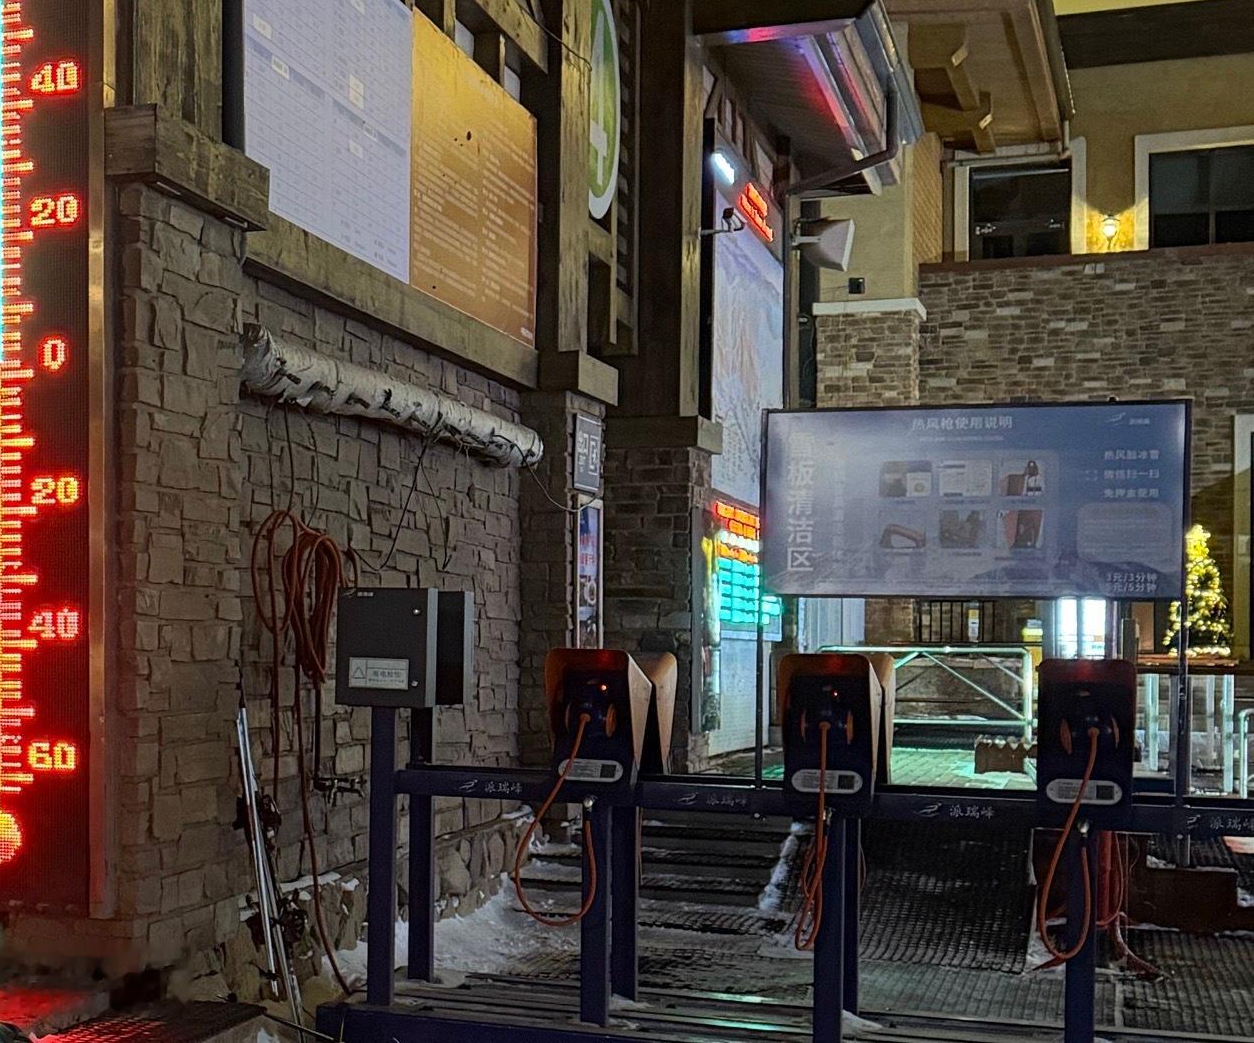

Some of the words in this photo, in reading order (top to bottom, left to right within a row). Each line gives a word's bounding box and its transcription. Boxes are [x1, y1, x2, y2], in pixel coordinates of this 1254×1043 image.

[30, 60, 80, 93] 40
[30, 195, 79, 227] 20
[42, 338, 67, 371] 0
[31, 475, 79, 506] 20
[786, 431, 815, 573] 雪板清洁区
[29, 608, 79, 639] 40
[29, 742, 77, 772] 60
